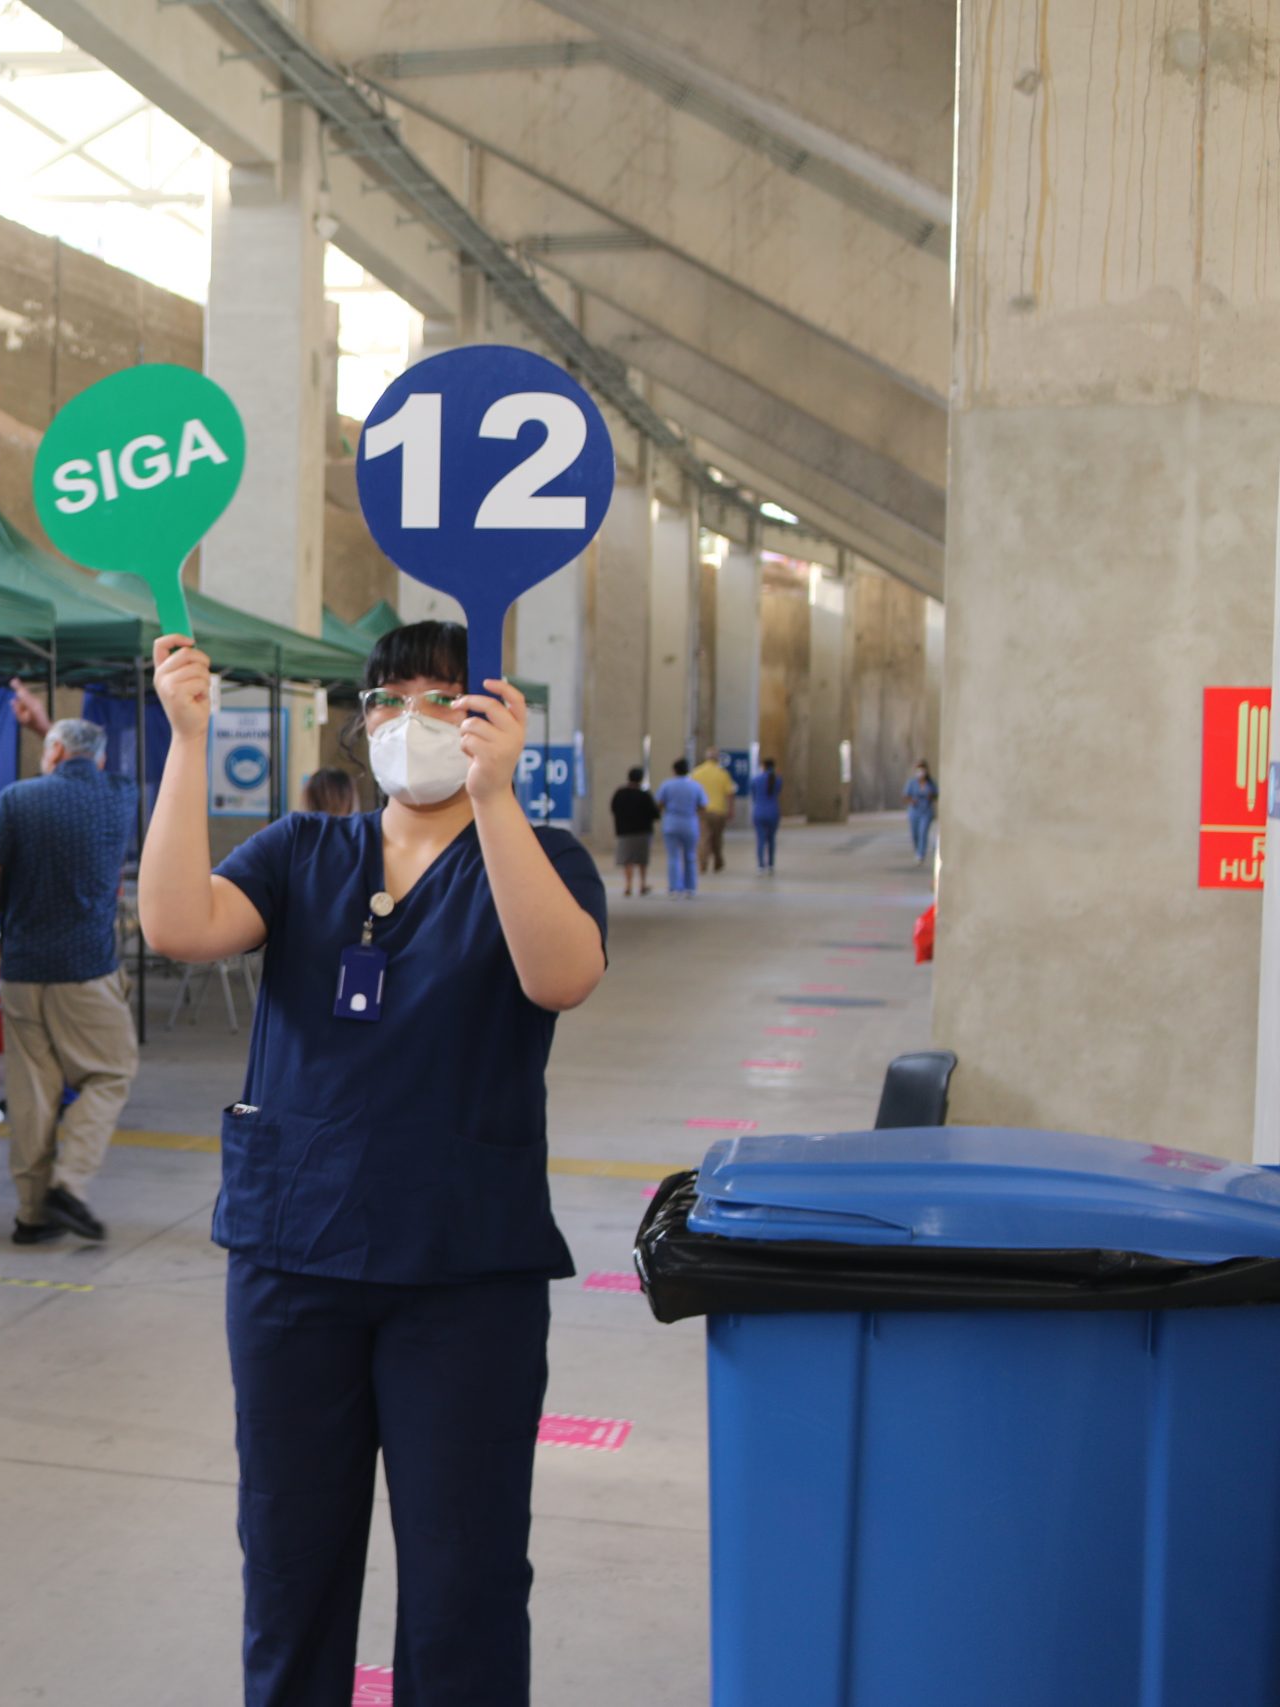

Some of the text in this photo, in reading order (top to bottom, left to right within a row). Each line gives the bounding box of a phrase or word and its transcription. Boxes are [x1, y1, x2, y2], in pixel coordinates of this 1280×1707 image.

[52, 418, 228, 514] SIGA
[365, 391, 587, 529] 12
[546, 759, 568, 785] 10
